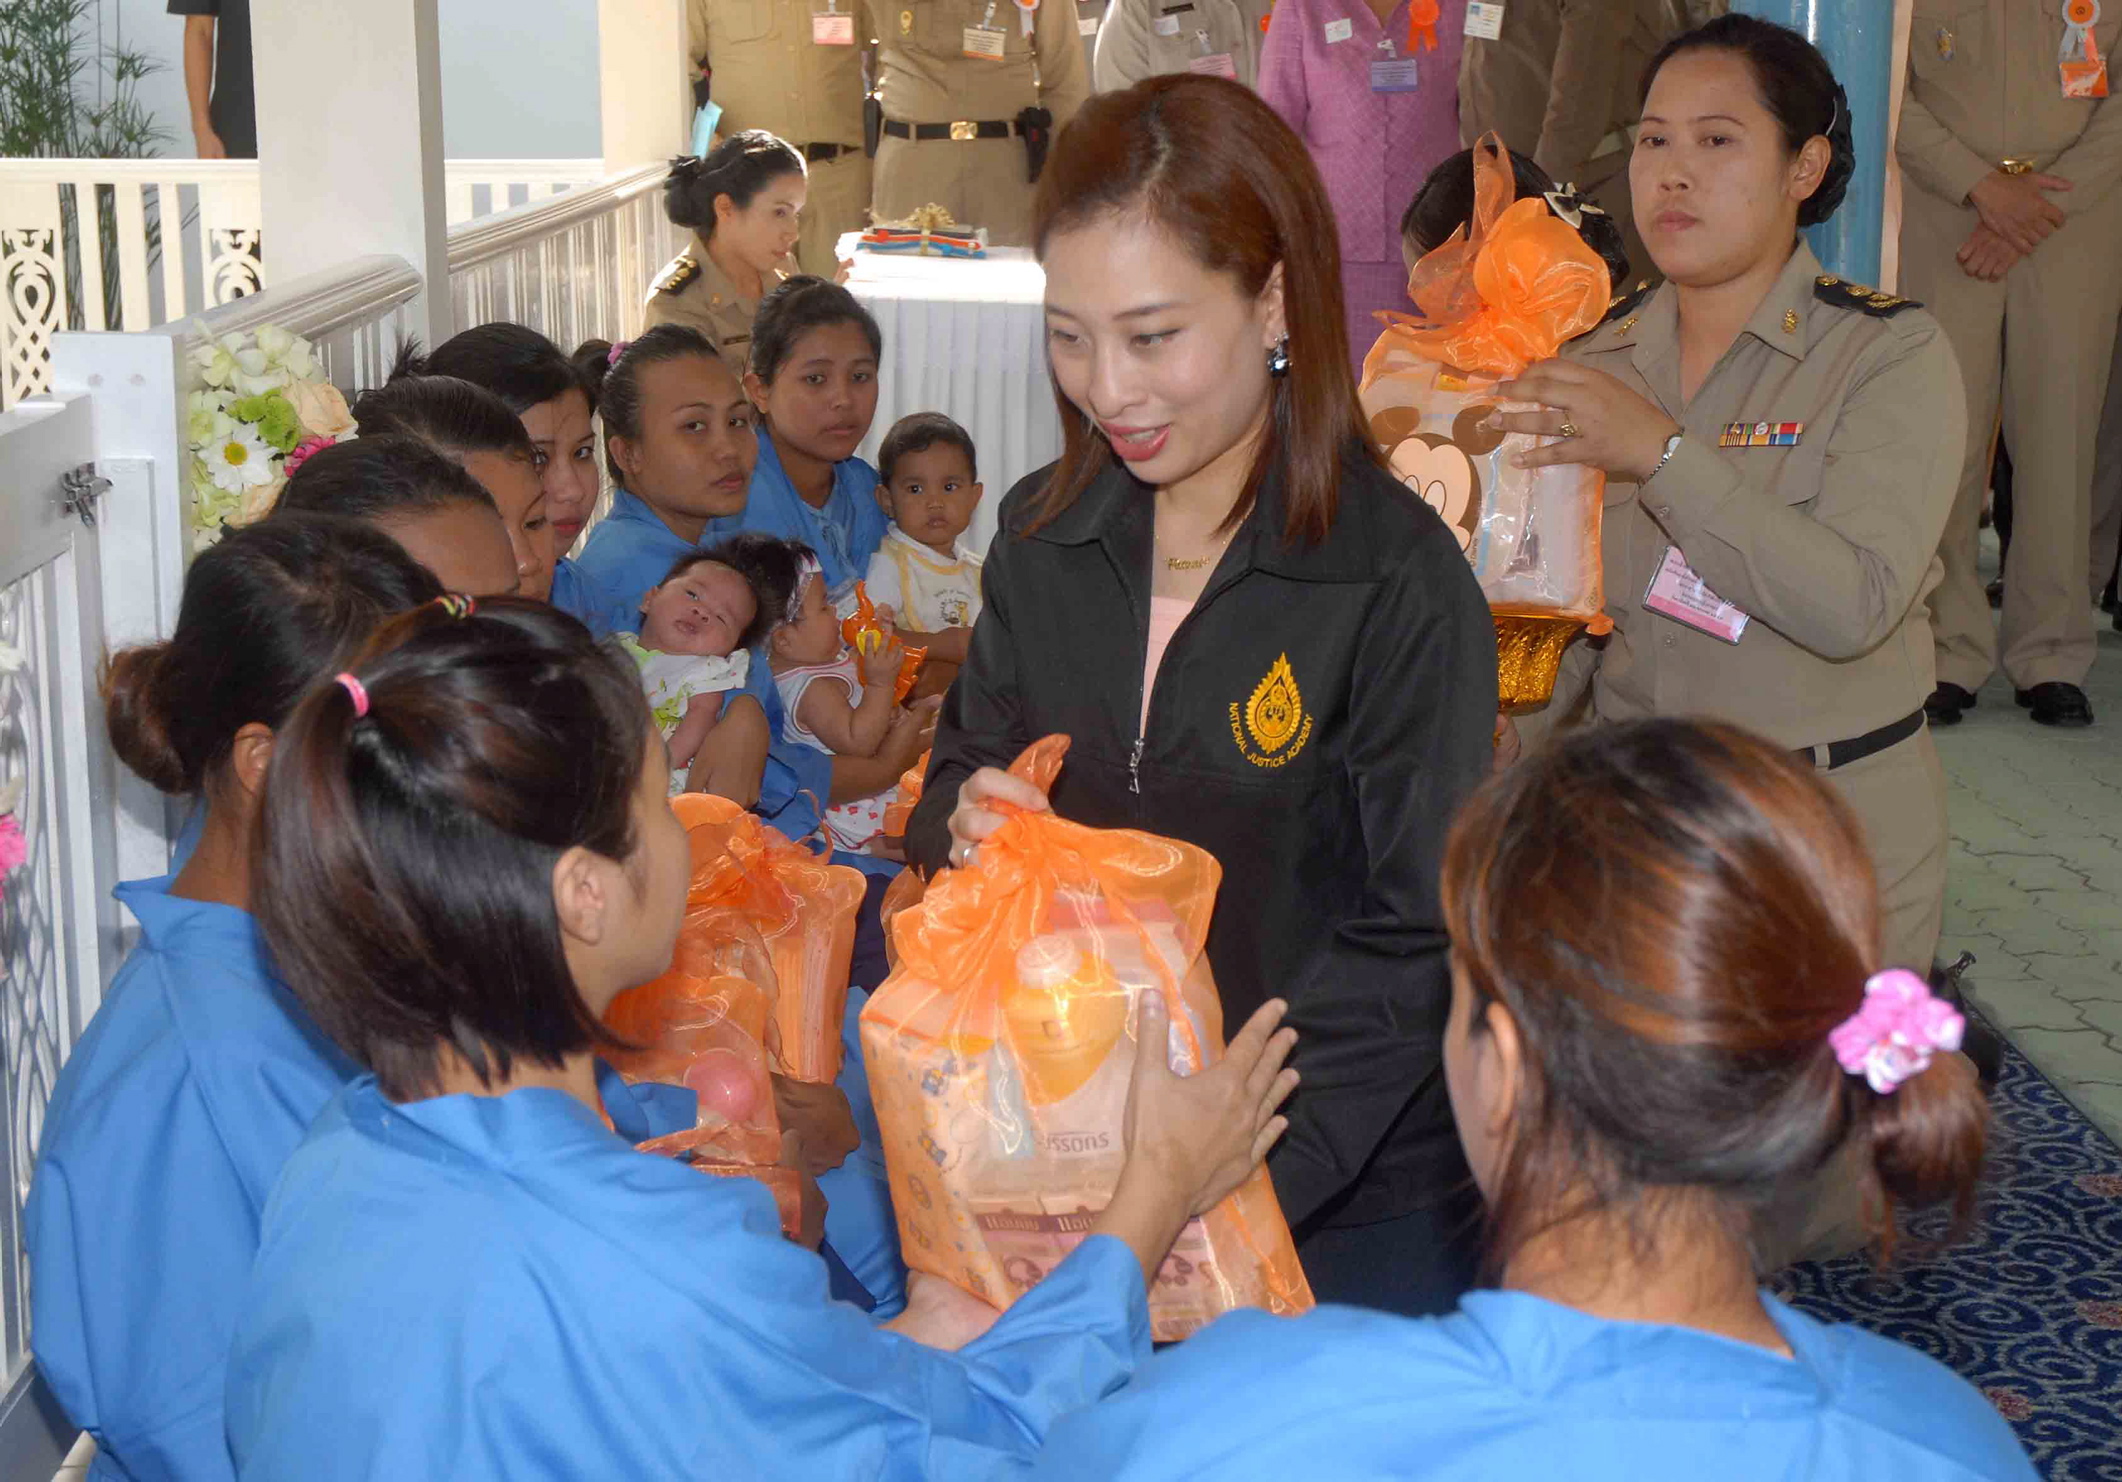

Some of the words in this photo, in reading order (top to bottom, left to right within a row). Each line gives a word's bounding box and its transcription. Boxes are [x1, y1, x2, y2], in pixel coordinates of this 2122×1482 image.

[1230, 702, 1247, 753] NATIONAL
[1247, 753, 1286, 767] JUSTICE
[1287, 714, 1313, 760] ACADEMY
